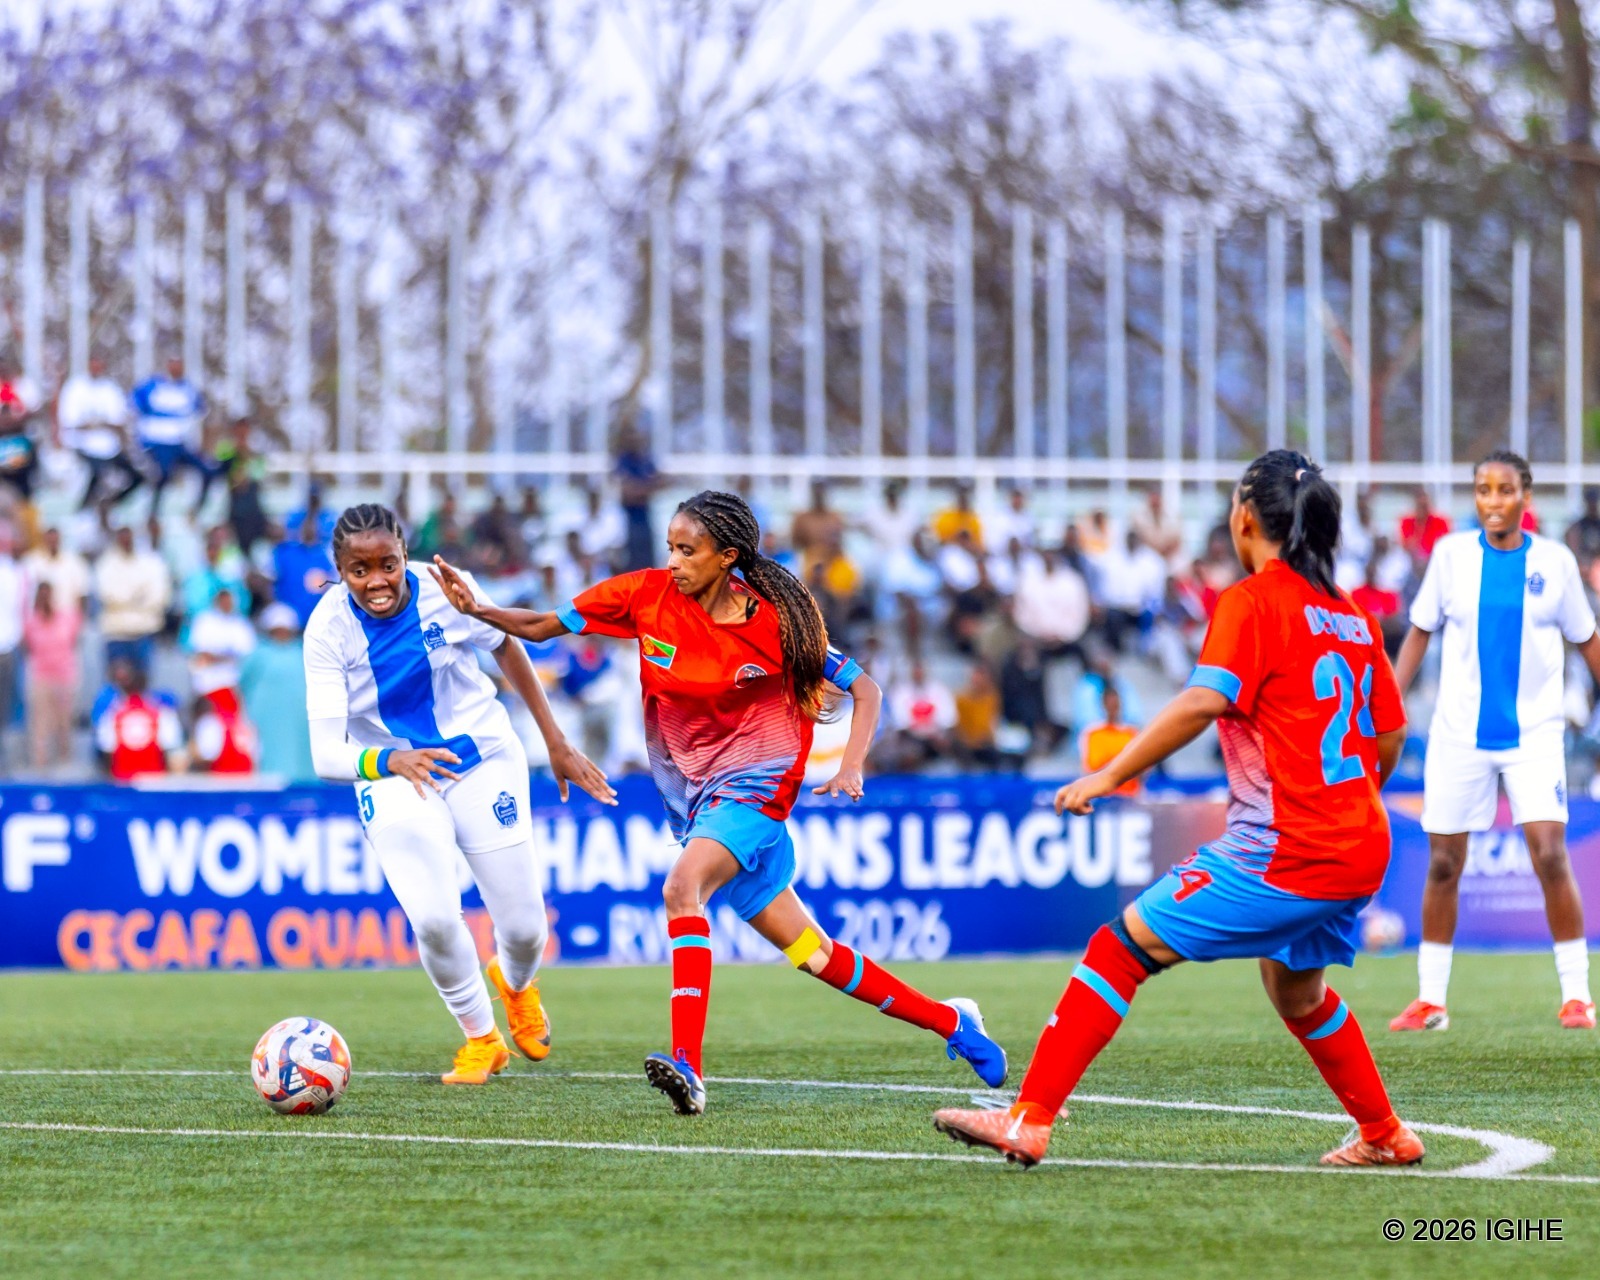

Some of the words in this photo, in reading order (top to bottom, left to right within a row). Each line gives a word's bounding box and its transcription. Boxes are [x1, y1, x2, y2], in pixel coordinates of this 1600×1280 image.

[899, 810, 1154, 889] LEAGUE
[57, 908, 262, 970] CECAFA
[832, 898, 952, 962] 2026
